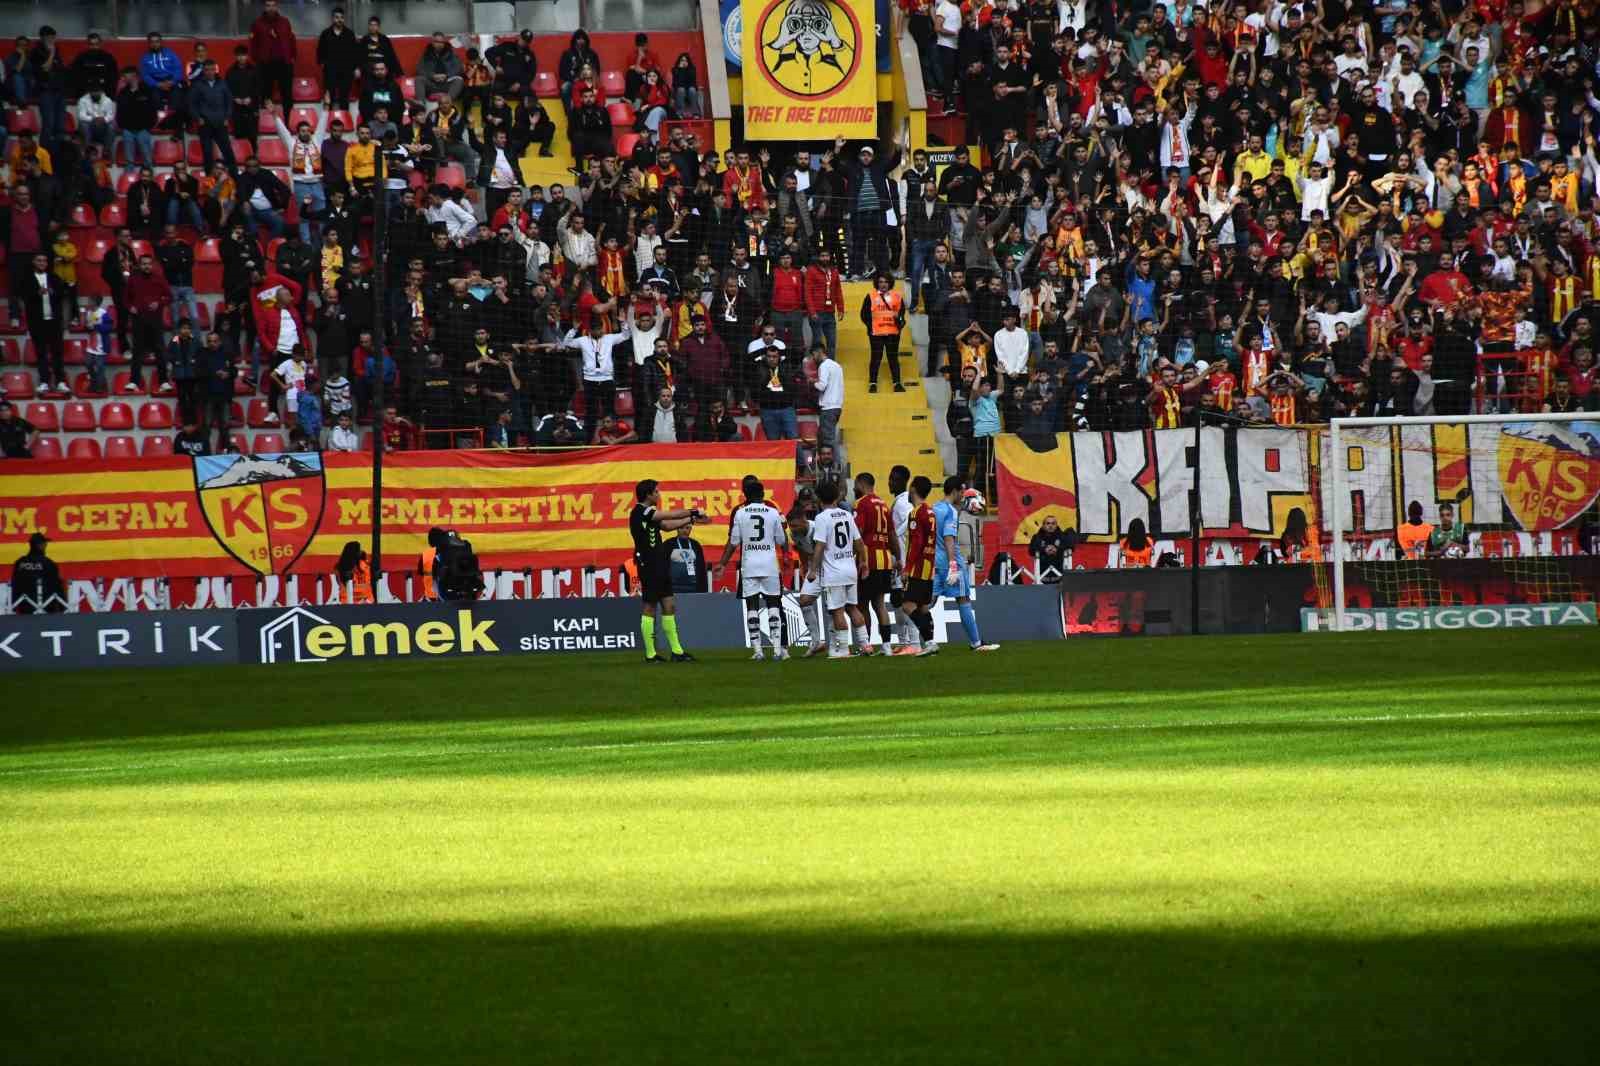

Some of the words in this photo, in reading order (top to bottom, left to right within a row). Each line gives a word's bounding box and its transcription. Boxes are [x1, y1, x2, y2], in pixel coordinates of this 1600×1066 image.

[748, 106, 783, 123] THEY
[786, 106, 817, 123] ARE
[818, 106, 875, 123] COMING
[0, 507, 48, 536] M,
[58, 501, 188, 533] CEFAM
[750, 514, 765, 541] 3
[249, 544, 295, 561] 1966
[553, 617, 599, 632] KAPI
[1307, 611, 1388, 632] HDI
[304, 609, 500, 657] emek
[520, 631, 636, 650] SİSTEMLERİ
